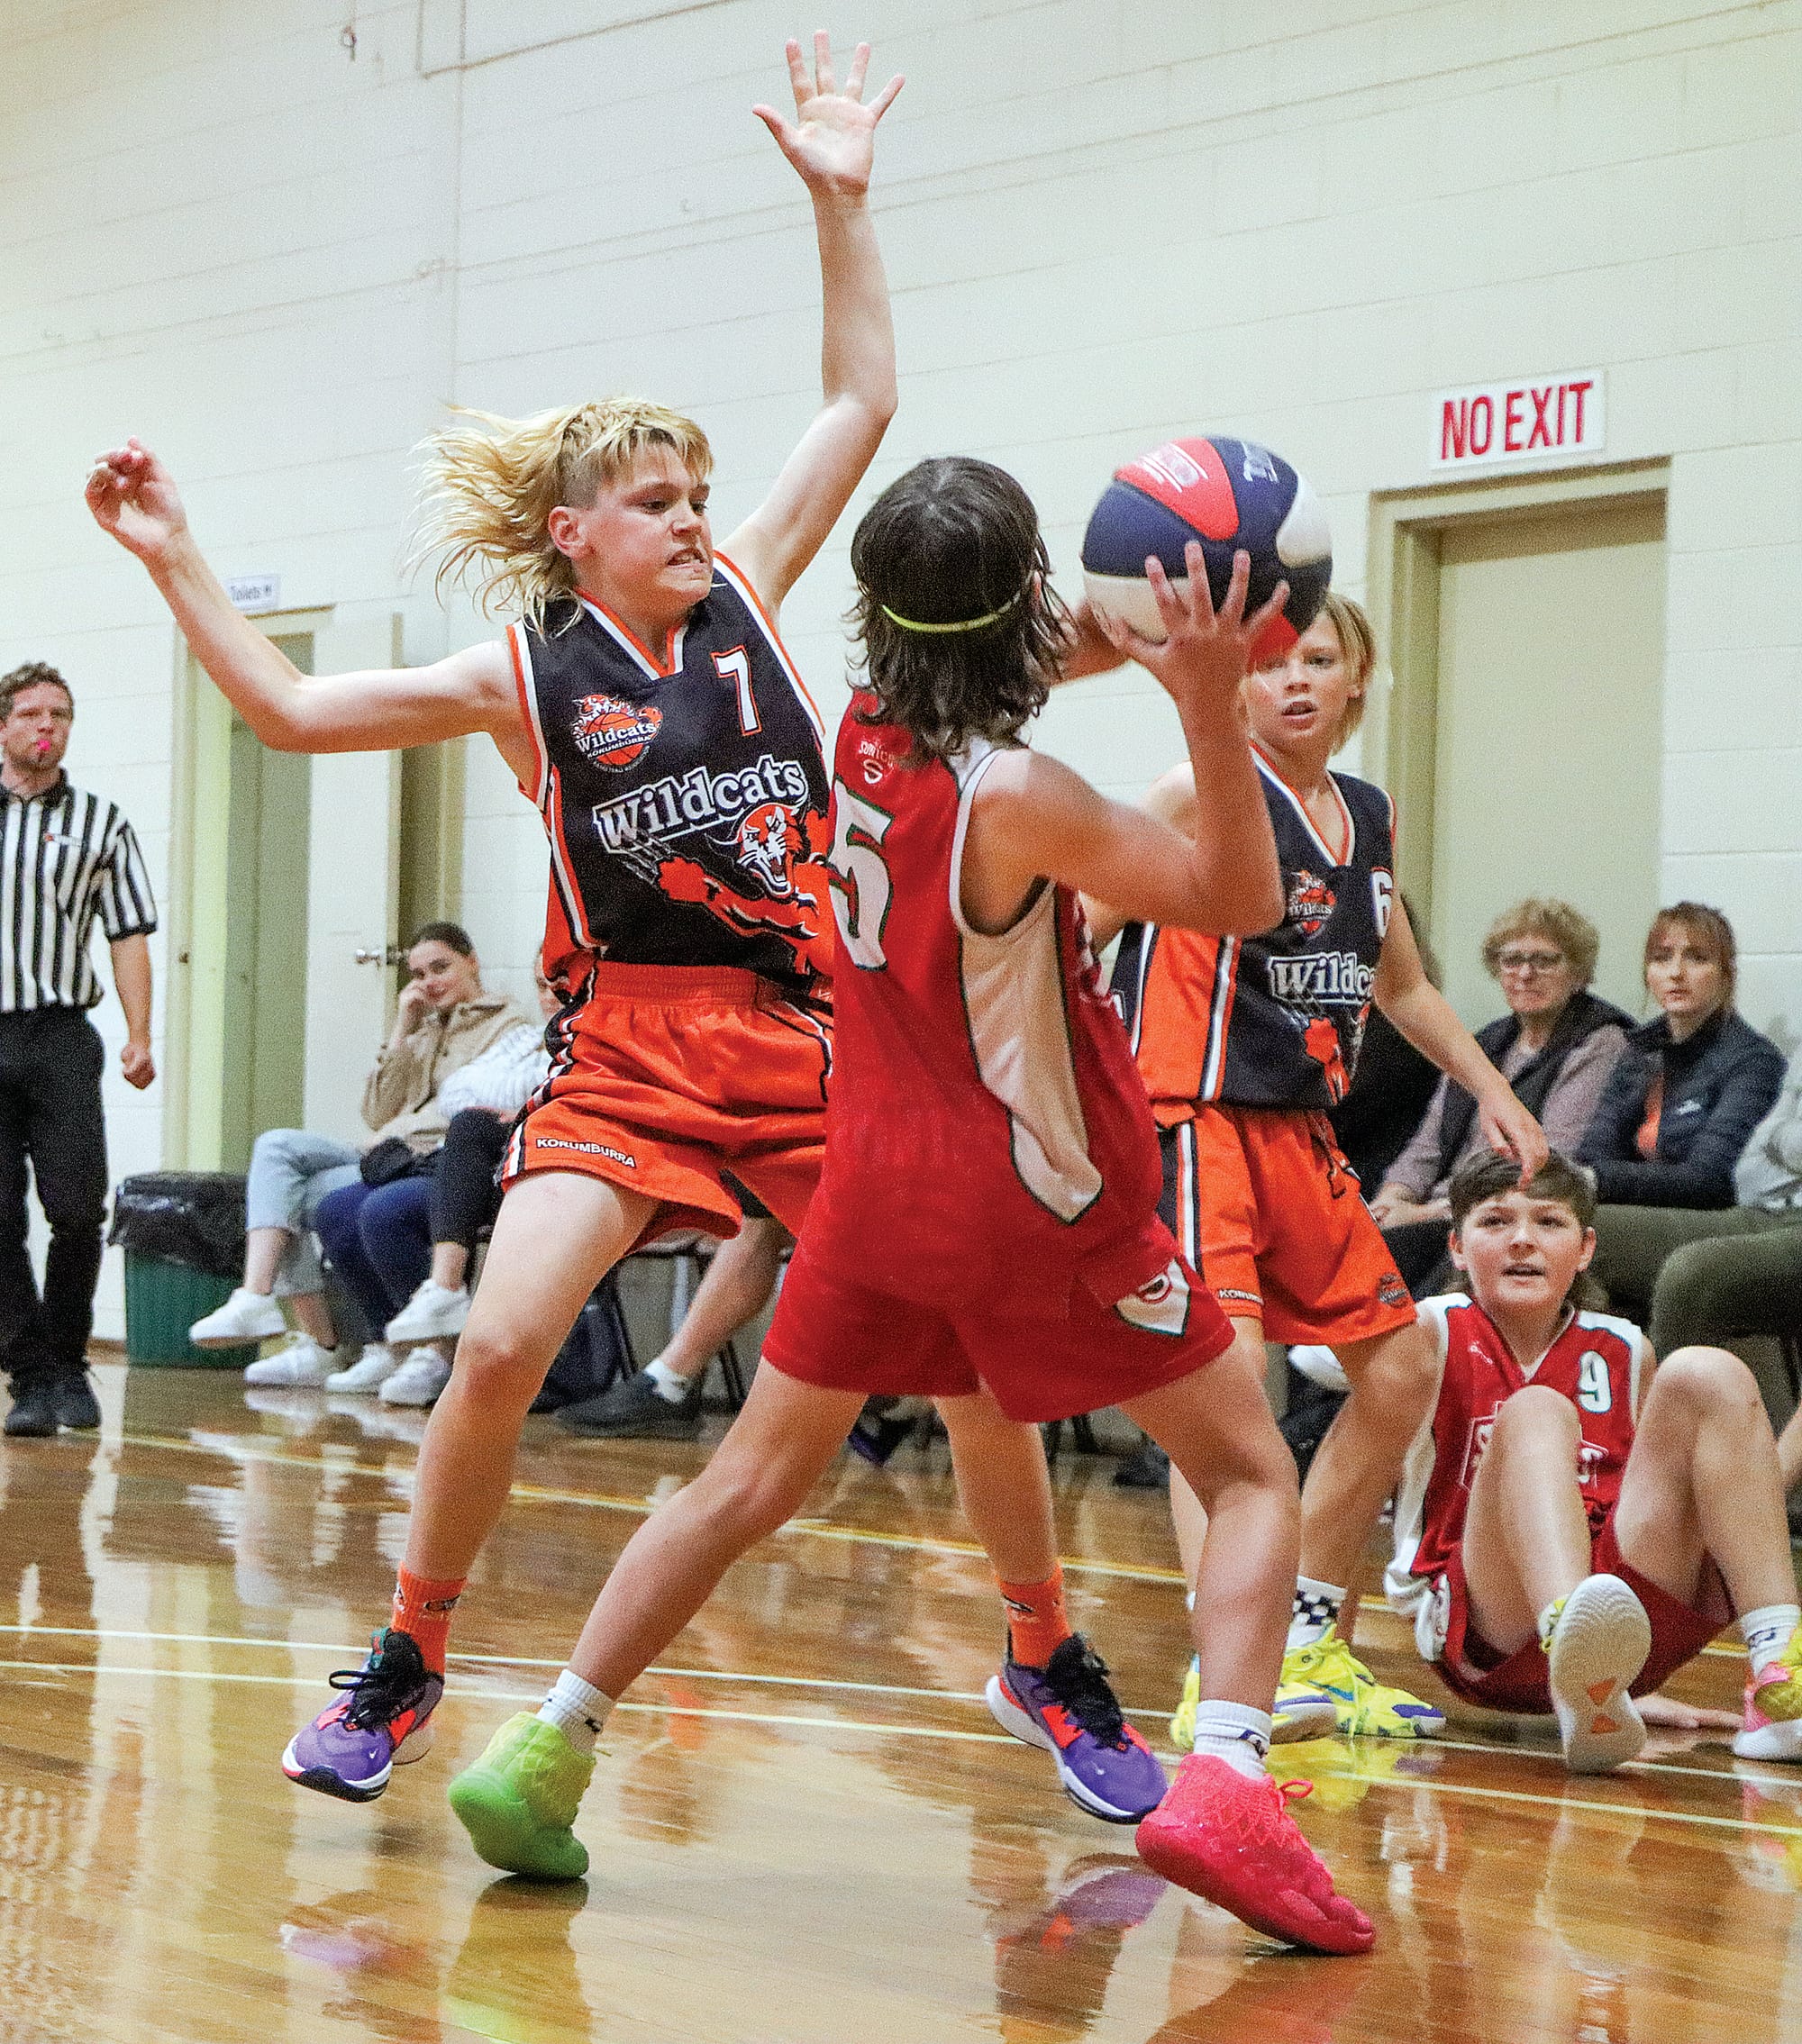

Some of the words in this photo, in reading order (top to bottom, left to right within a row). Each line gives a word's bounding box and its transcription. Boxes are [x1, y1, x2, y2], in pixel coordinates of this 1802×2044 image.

[1442, 395, 1493, 459] NO
[1504, 380, 1593, 452] EXIT
[230, 585, 262, 602] Toilets
[710, 644, 763, 737] 7
[575, 722, 658, 754] Wildcats
[594, 755, 809, 853] Wildcats
[827, 775, 895, 973] 5
[1370, 867, 1394, 940] 6
[1269, 951, 1376, 1005] Wildc
[536, 1138, 637, 1168] KORUMBURRA
[1578, 1350, 1613, 1414] 9
